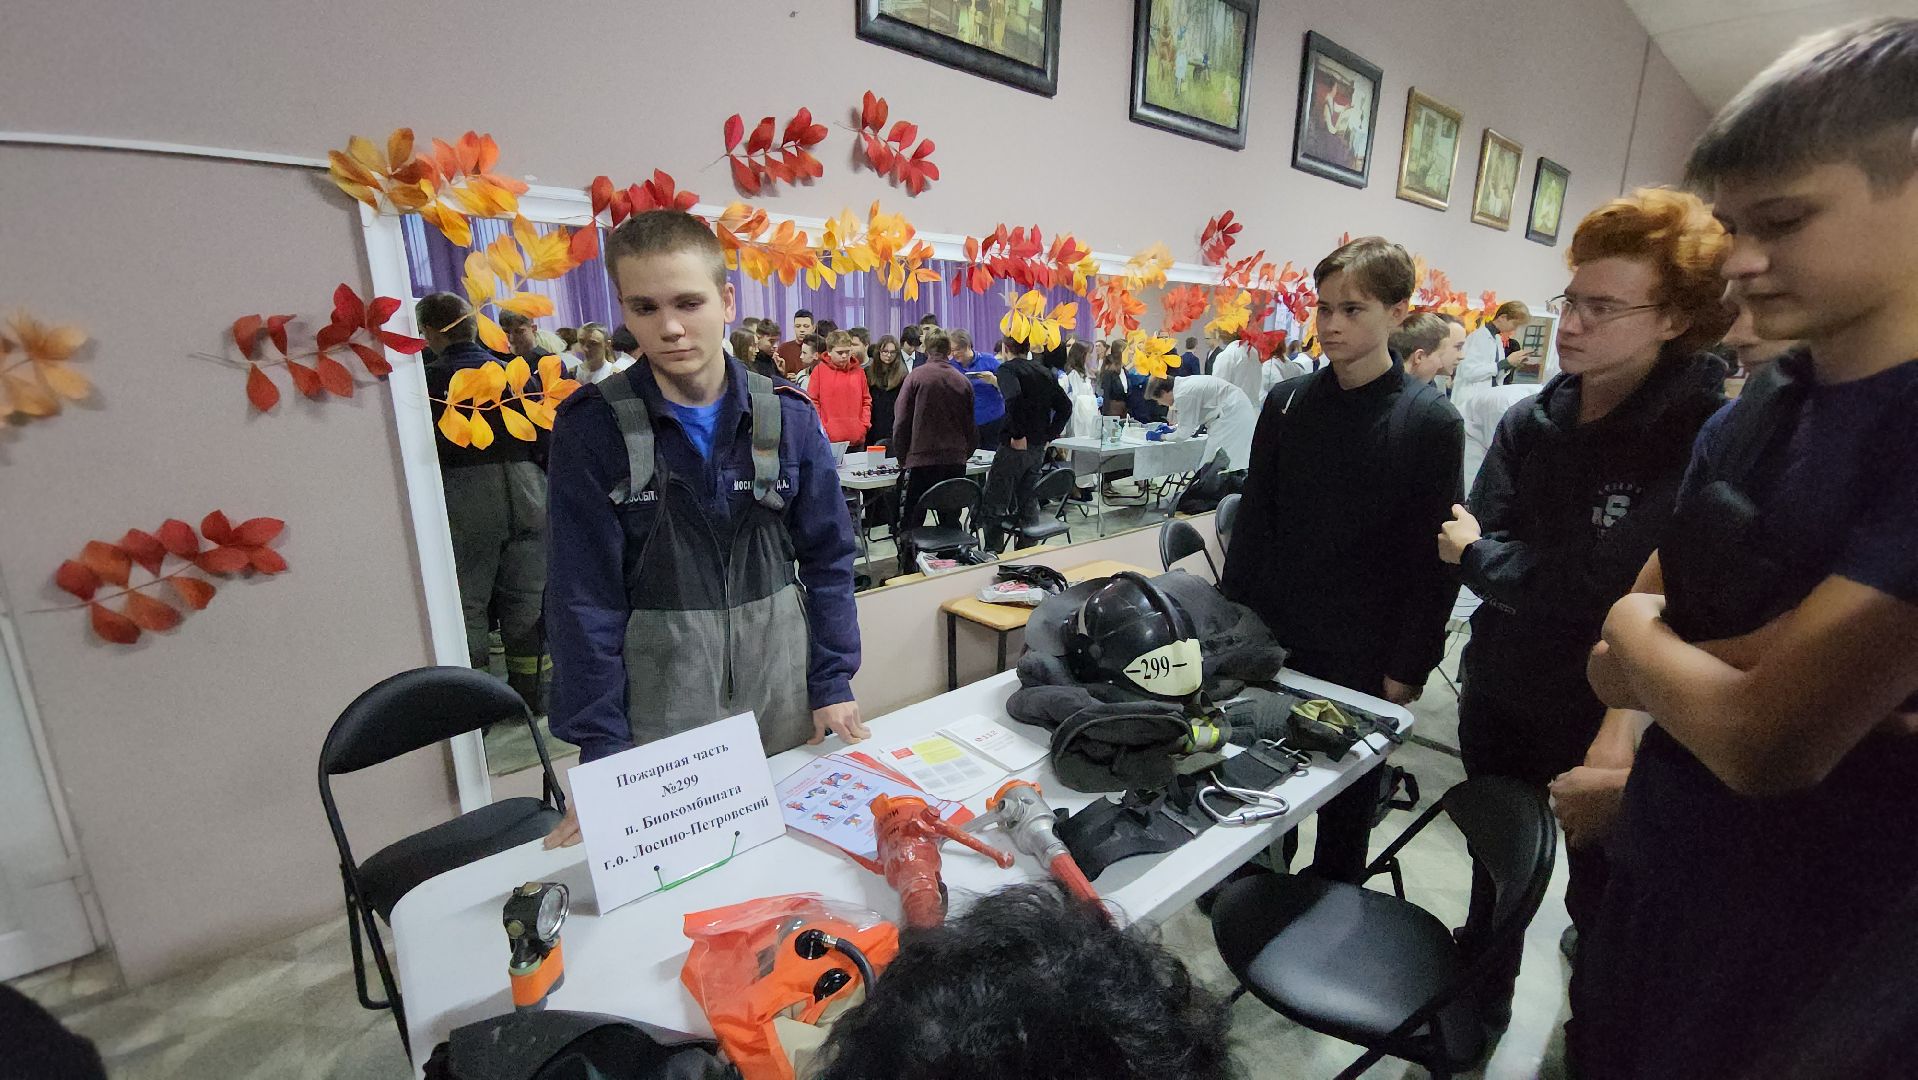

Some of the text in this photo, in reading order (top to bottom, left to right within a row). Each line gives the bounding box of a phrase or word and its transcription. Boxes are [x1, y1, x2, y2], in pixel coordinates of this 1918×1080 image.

[616, 743, 729, 788] Пожарная часть
[661, 774, 699, 797] №299
[642, 785, 742, 830] Биокомбината
[603, 796, 770, 871] г.о. Лосино-Петровский
